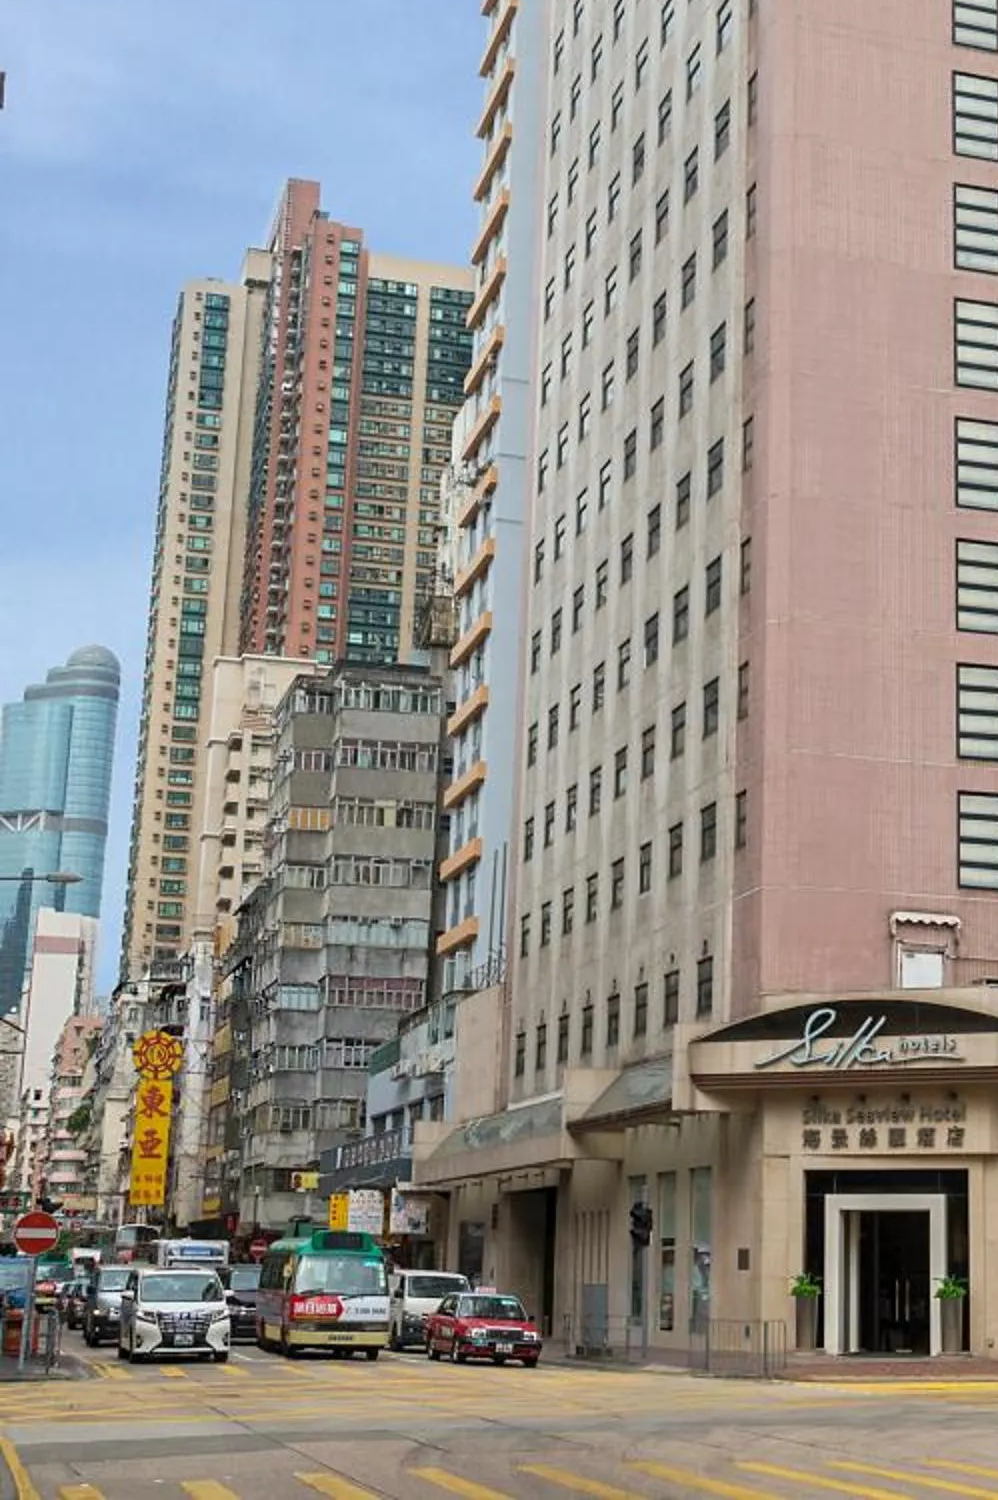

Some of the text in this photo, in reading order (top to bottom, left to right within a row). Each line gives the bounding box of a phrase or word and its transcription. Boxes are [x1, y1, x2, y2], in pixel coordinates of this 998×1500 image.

[755, 1008, 894, 1069] Silka
[802, 1103, 967, 1125] Silka Seaview Hotel
[802, 1126, 965, 1149] 海景絲麗酒店
